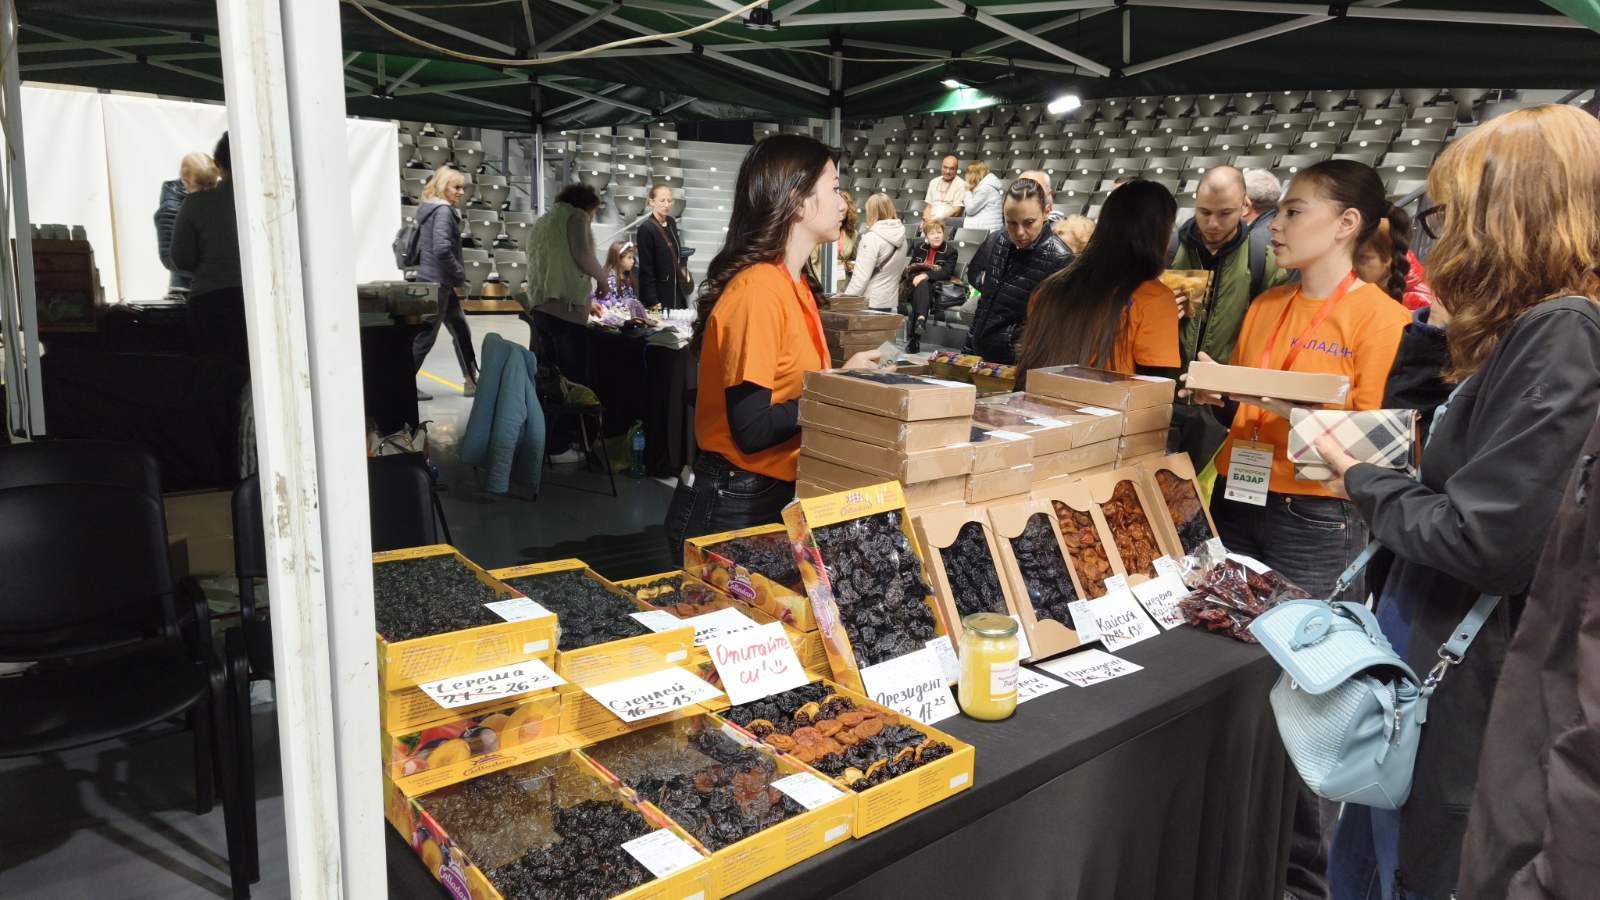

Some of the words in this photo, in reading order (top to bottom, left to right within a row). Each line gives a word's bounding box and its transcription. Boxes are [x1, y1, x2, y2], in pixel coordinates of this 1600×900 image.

[1233, 473, 1264, 484] БАЗАР
[1096, 610, 1138, 631] Кайсия
[716, 637, 790, 666] Опитайте
[427, 669, 524, 693] Череша
[876, 678, 941, 707] Президент
[608, 682, 686, 710] Стенлей
